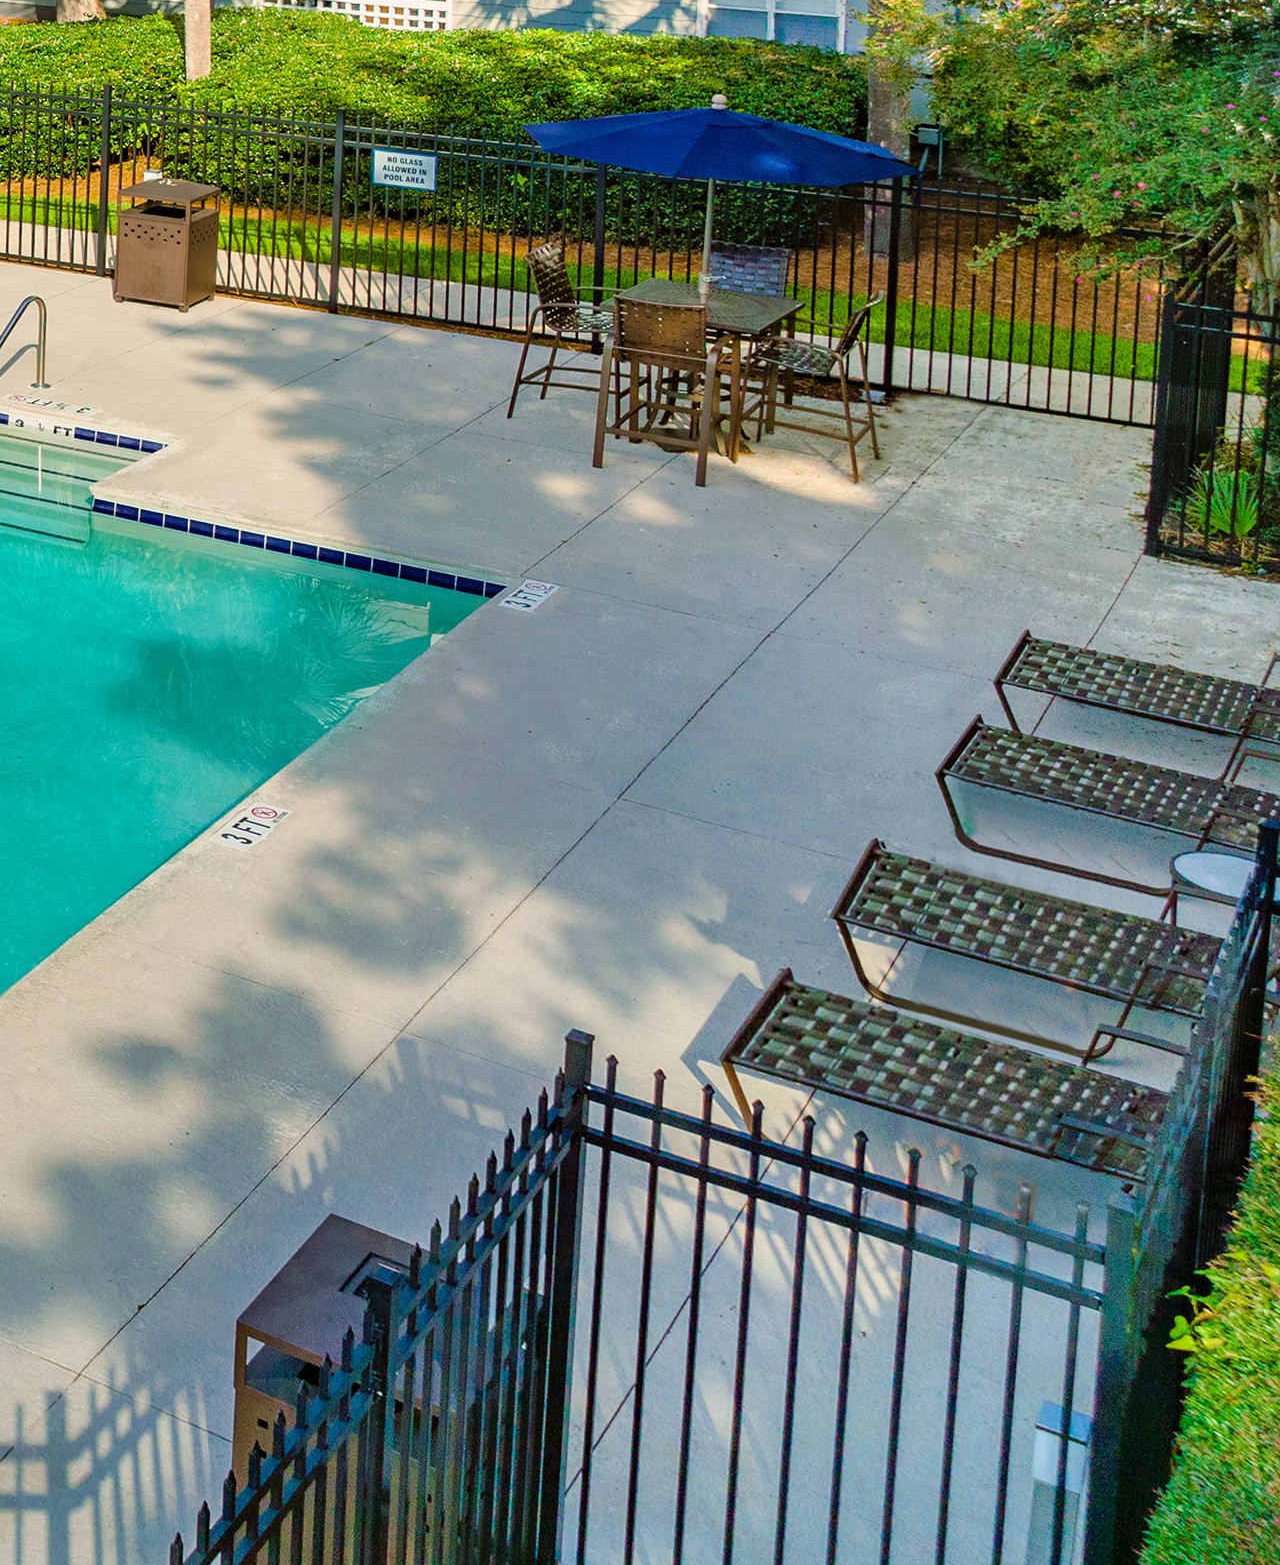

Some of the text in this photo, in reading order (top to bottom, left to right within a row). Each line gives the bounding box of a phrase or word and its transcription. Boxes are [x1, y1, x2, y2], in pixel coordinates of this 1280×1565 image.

[387, 156, 423, 167] NO GLASS
[382, 164, 427, 176] ALLOWED IN
[383, 174, 425, 184] POOL AREA
[14, 418, 25, 428] 3
[52, 425, 73, 437] FT
[511, 589, 544, 603] FT
[504, 600, 532, 608] 3
[231, 816, 272, 836] FT
[221, 832, 253, 845] 3
